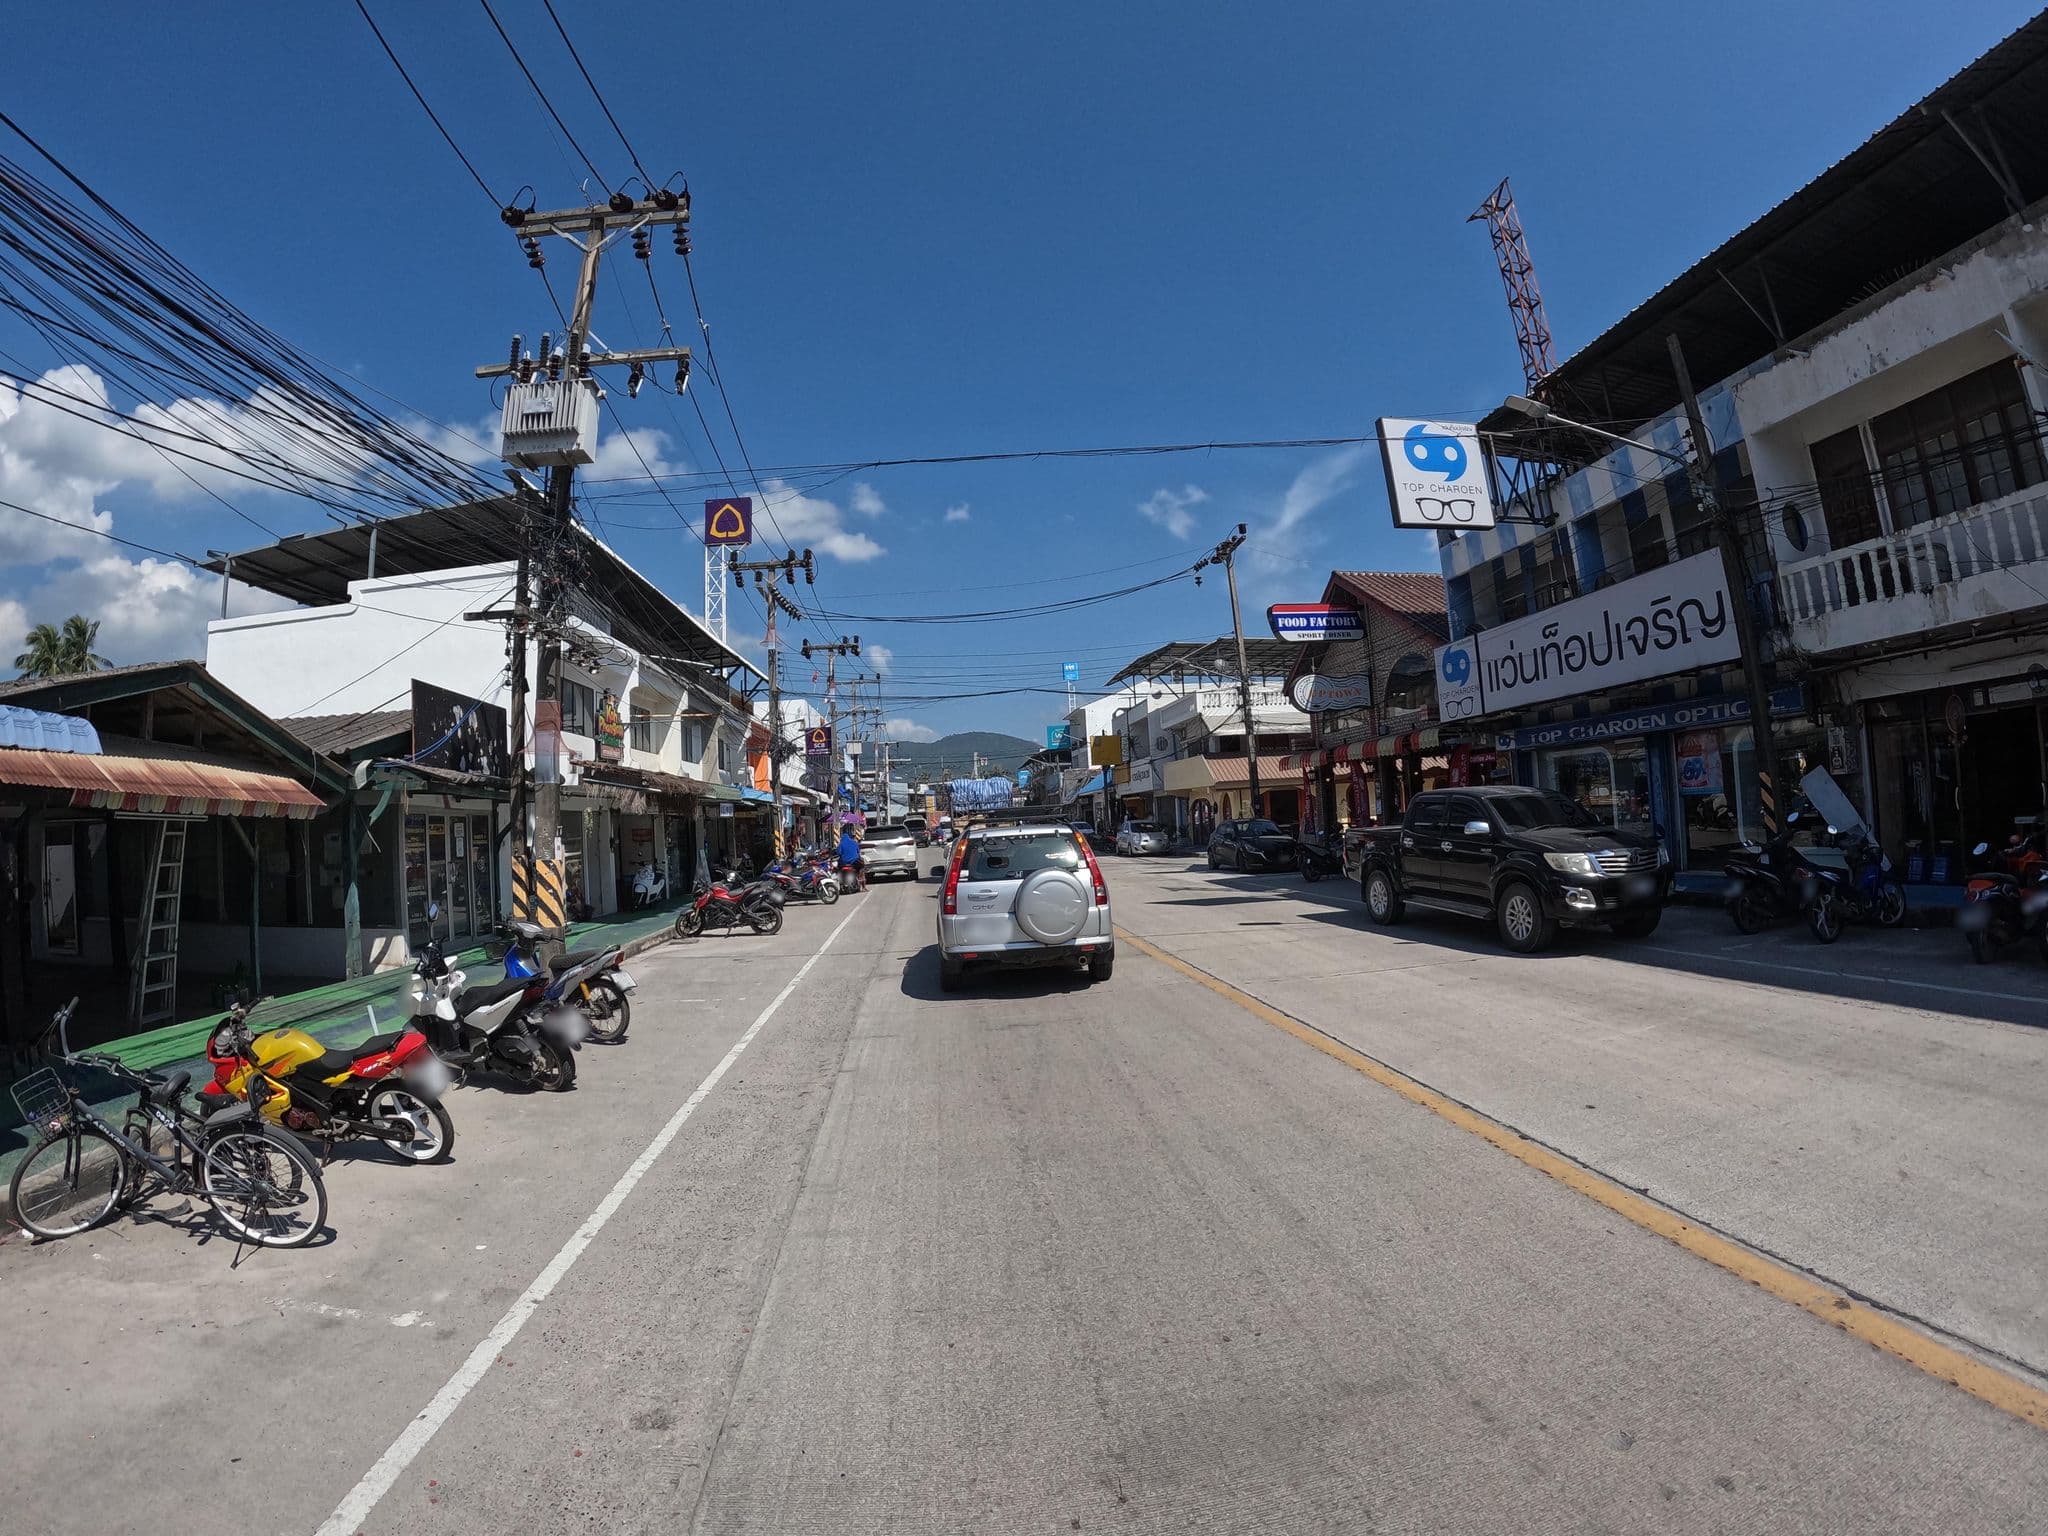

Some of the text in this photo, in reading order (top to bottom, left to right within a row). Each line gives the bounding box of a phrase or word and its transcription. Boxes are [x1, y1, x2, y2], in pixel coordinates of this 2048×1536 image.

[1402, 483, 1483, 494] TOP CHAROEN
[1278, 616, 1357, 628] FOOD FACTORY
[1486, 590, 1726, 693] แว่นท็อปเจริญ
[1528, 695, 1785, 744] TOP CHAROEN OPTICL
